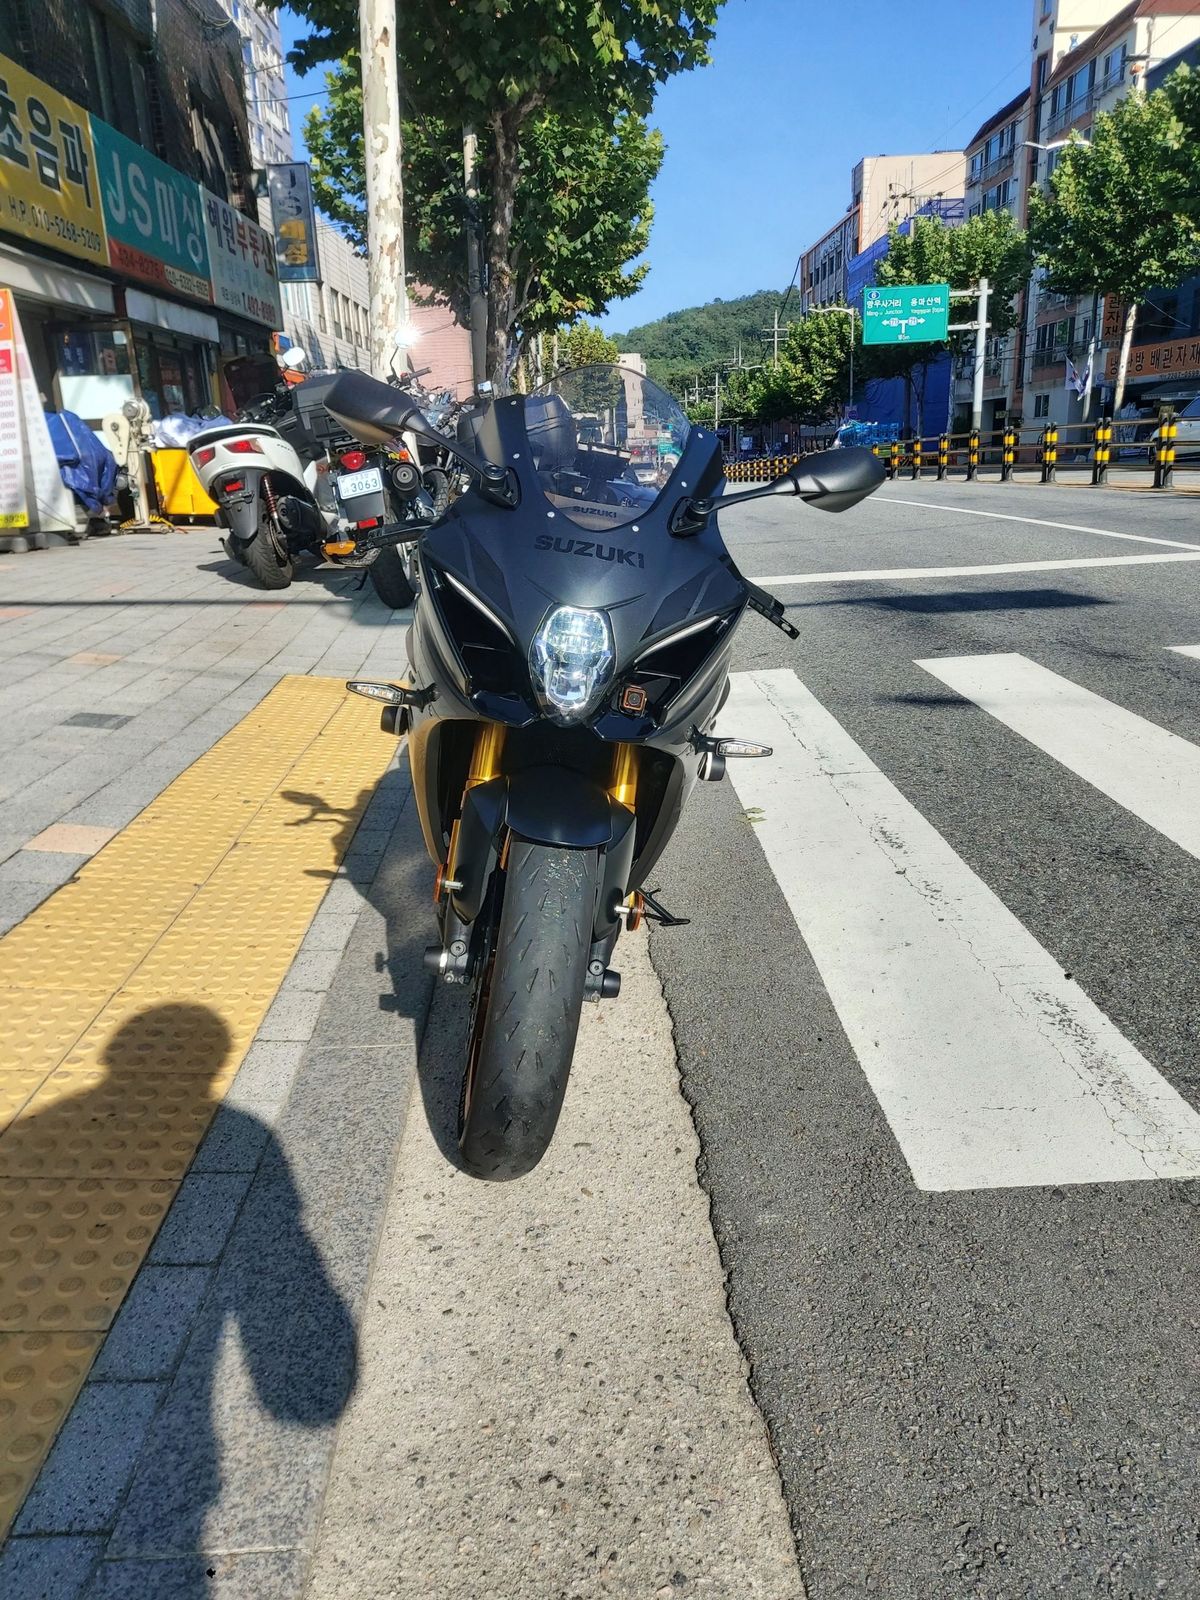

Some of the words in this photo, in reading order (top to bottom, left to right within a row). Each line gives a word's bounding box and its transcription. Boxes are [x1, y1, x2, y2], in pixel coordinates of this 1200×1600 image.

[1150, 342, 1200, 370] 배관자재
[350, 478, 378, 493] 3063
[572, 505, 617, 519] SUZUKI
[534, 534, 645, 569] SUZUKI
